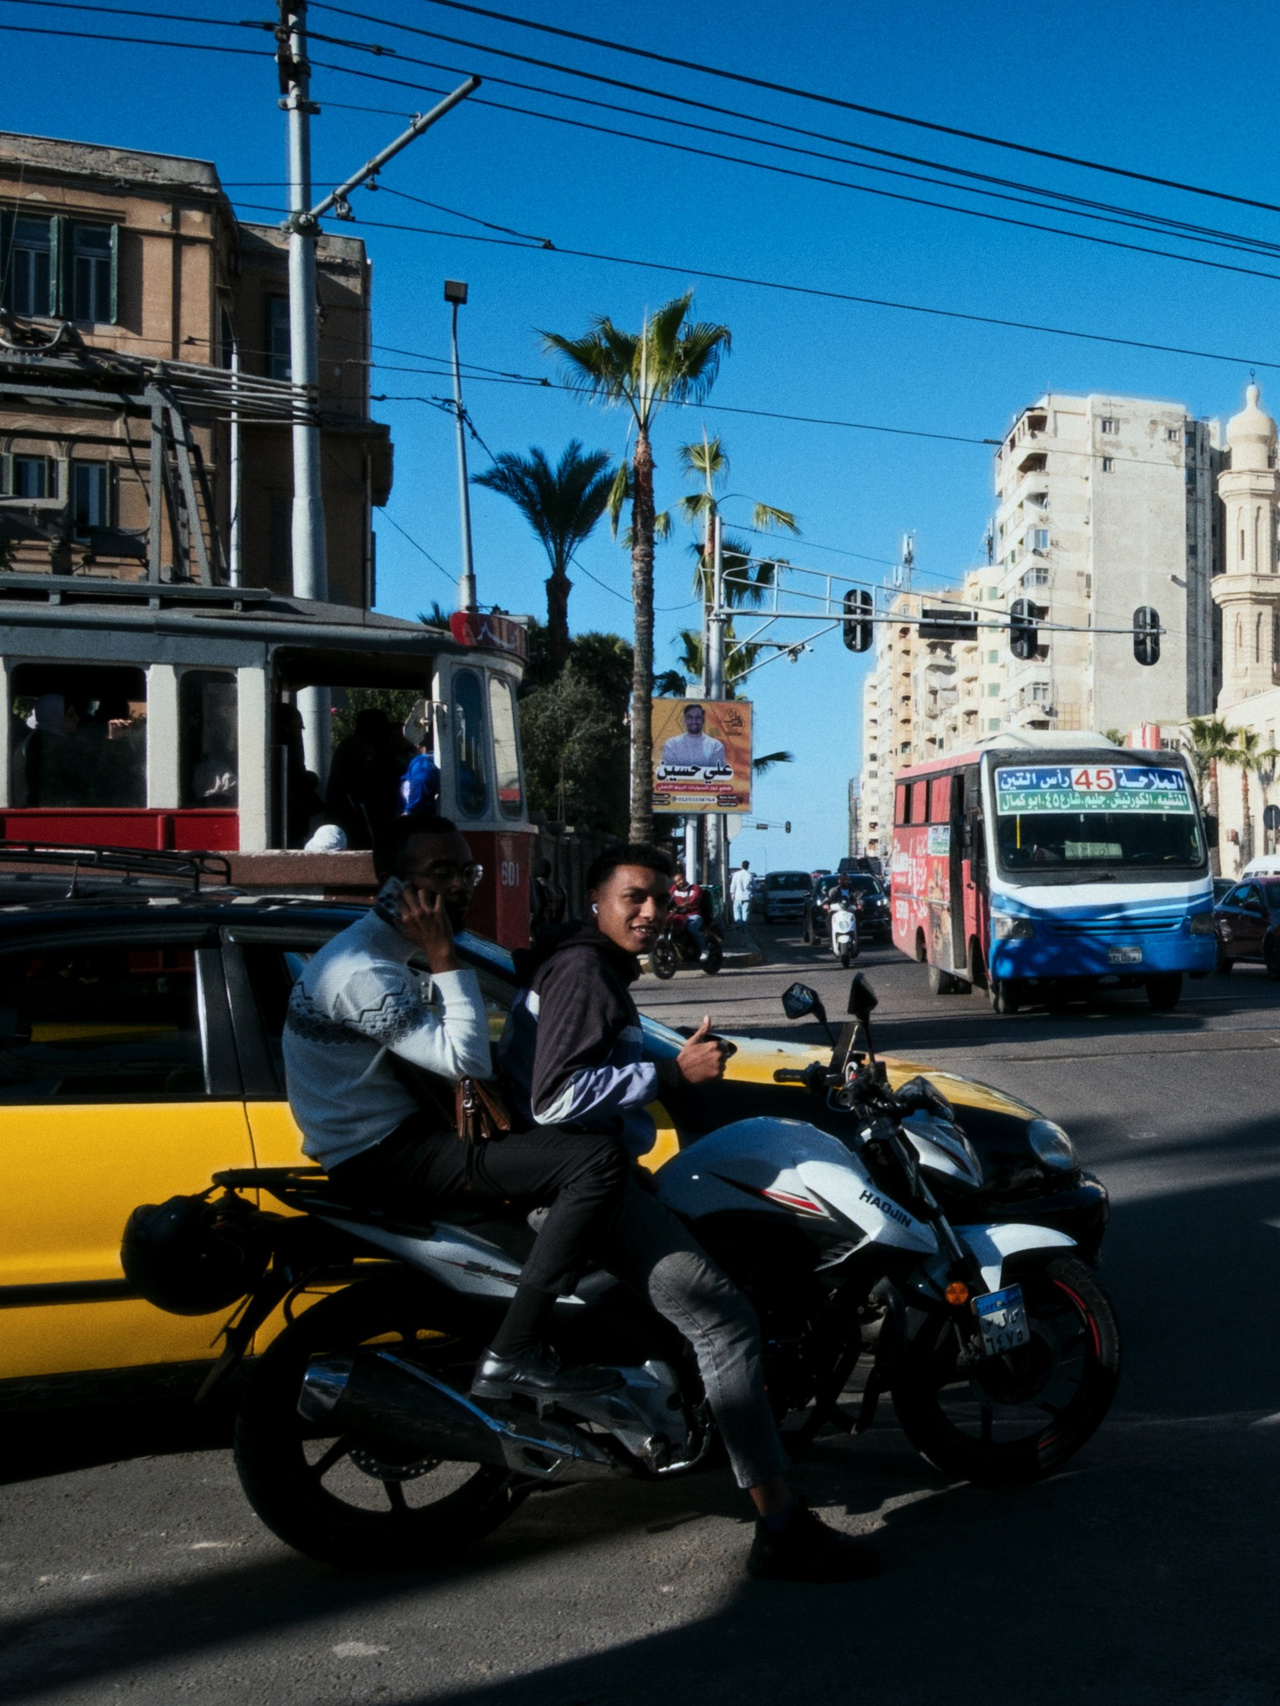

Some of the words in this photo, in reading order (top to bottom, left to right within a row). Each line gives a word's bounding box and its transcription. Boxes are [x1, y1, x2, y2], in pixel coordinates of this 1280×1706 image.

[657, 762, 701, 781] حسين
[703, 761, 733, 784] علي
[1000, 771, 1037, 790] التين
[1040, 770, 1070, 788] رأس
[1074, 769, 1114, 790] 45
[501, 861, 519, 887] 601
[859, 1189, 912, 1229] HAOJIN
